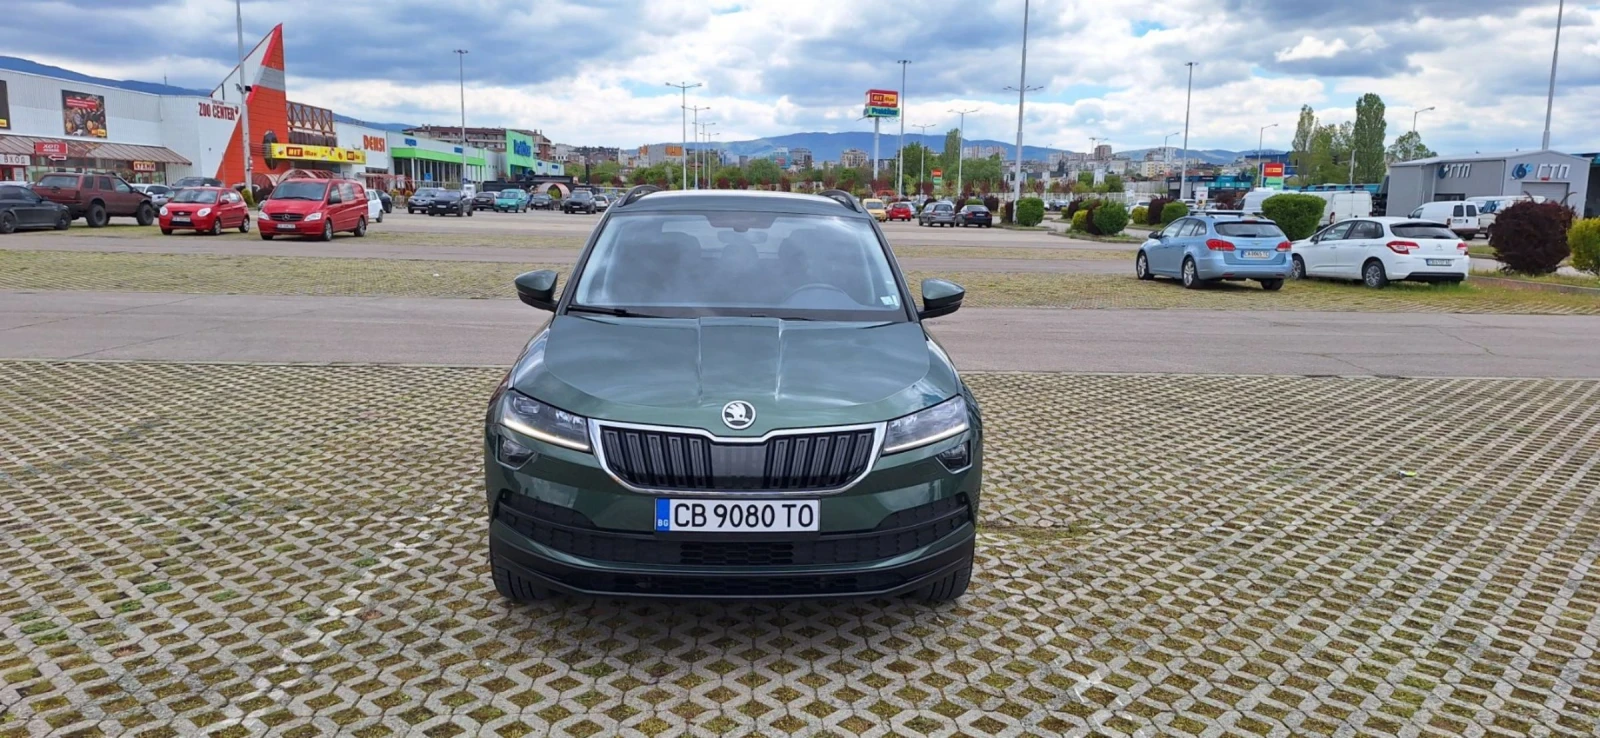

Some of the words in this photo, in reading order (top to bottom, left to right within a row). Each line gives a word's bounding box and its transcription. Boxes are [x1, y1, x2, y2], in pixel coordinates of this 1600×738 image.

[198, 102, 211, 117] ZOO
[212, 104, 236, 121] CENTER
[1448, 163, 1471, 178] ГТП
[1536, 163, 1571, 179] ГТП
[657, 519, 669, 527] BG
[674, 503, 707, 528] CB
[713, 503, 776, 528] 9080
[781, 503, 814, 528] TO
